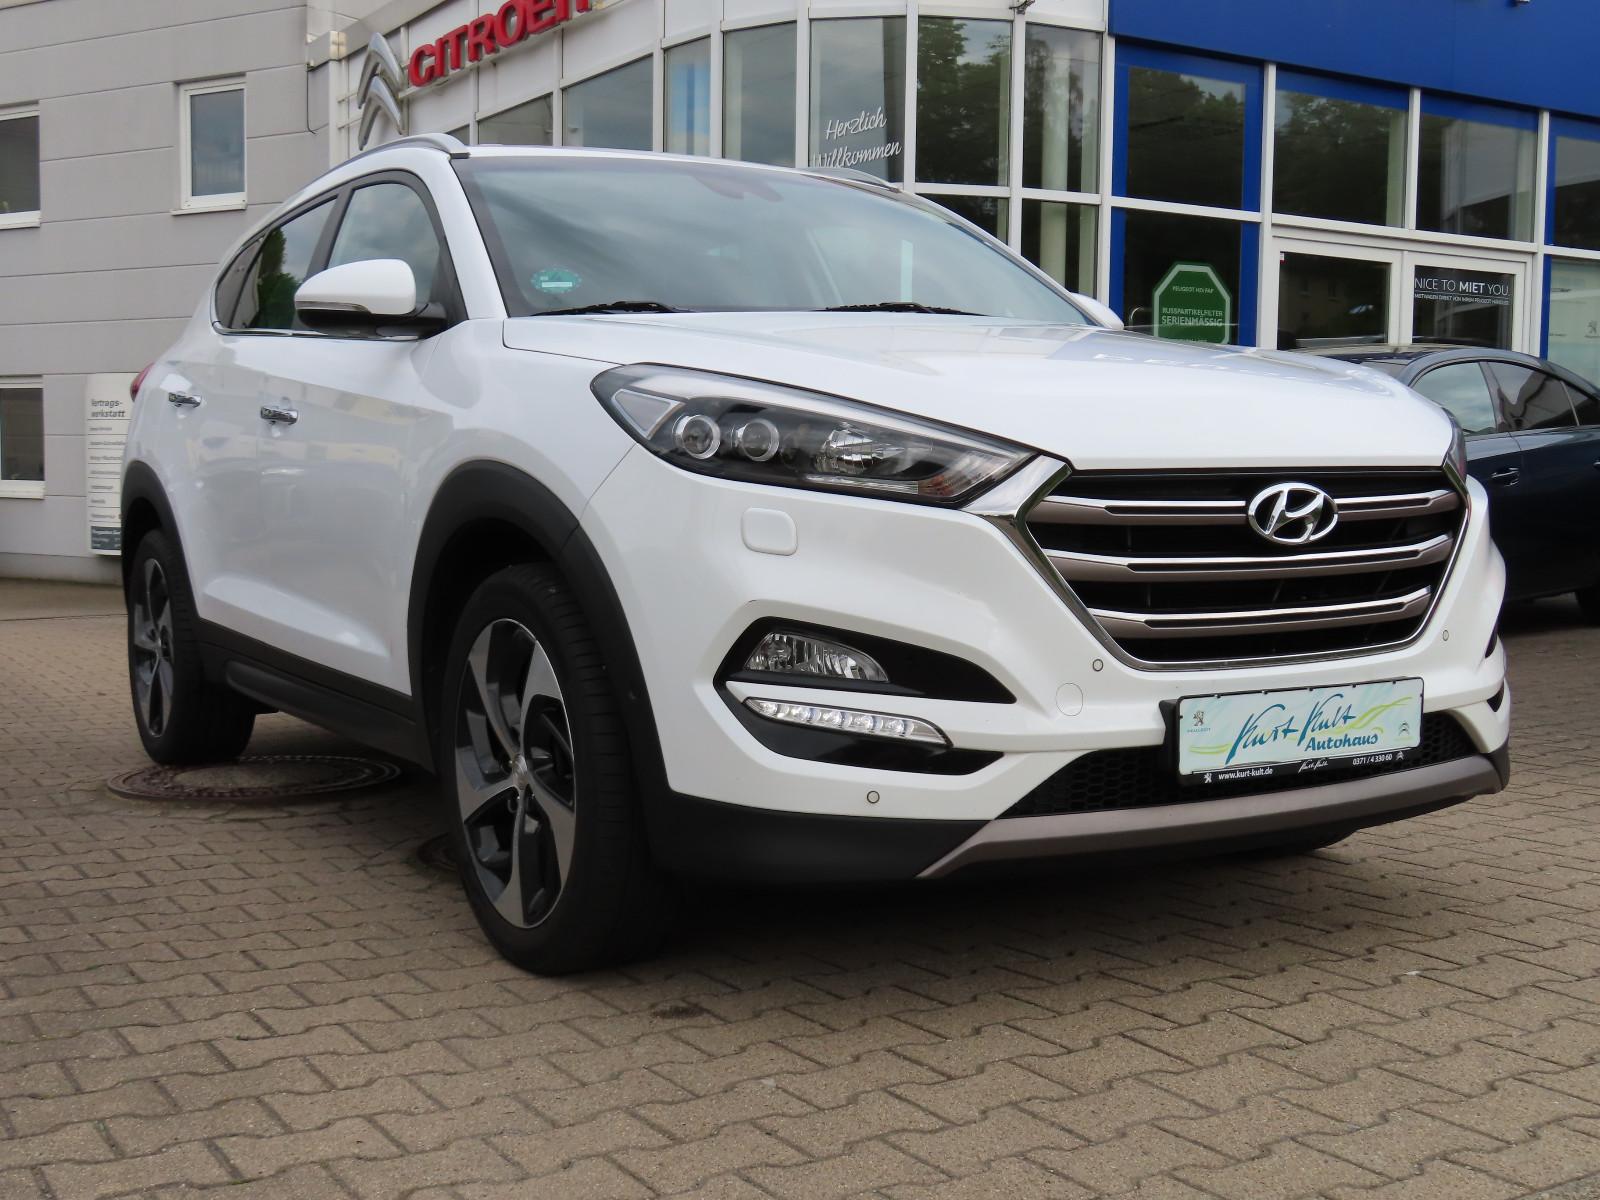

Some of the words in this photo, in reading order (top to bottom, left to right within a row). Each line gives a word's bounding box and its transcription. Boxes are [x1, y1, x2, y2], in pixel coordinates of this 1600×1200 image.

[823, 106, 888, 140] Herzlich
[813, 141, 903, 168] Willkommen
[1415, 278, 1438, 290] NICE
[1440, 279, 1456, 291] TO
[1459, 281, 1486, 293] MIET
[1161, 315, 1223, 327] SERIENMÄSSIG
[1224, 703, 1299, 766] Kurt
[1297, 693, 1357, 747] Kult
[1304, 732, 1379, 752] Autohaus
[1218, 766, 1273, 780] www.kurt-kult.de
